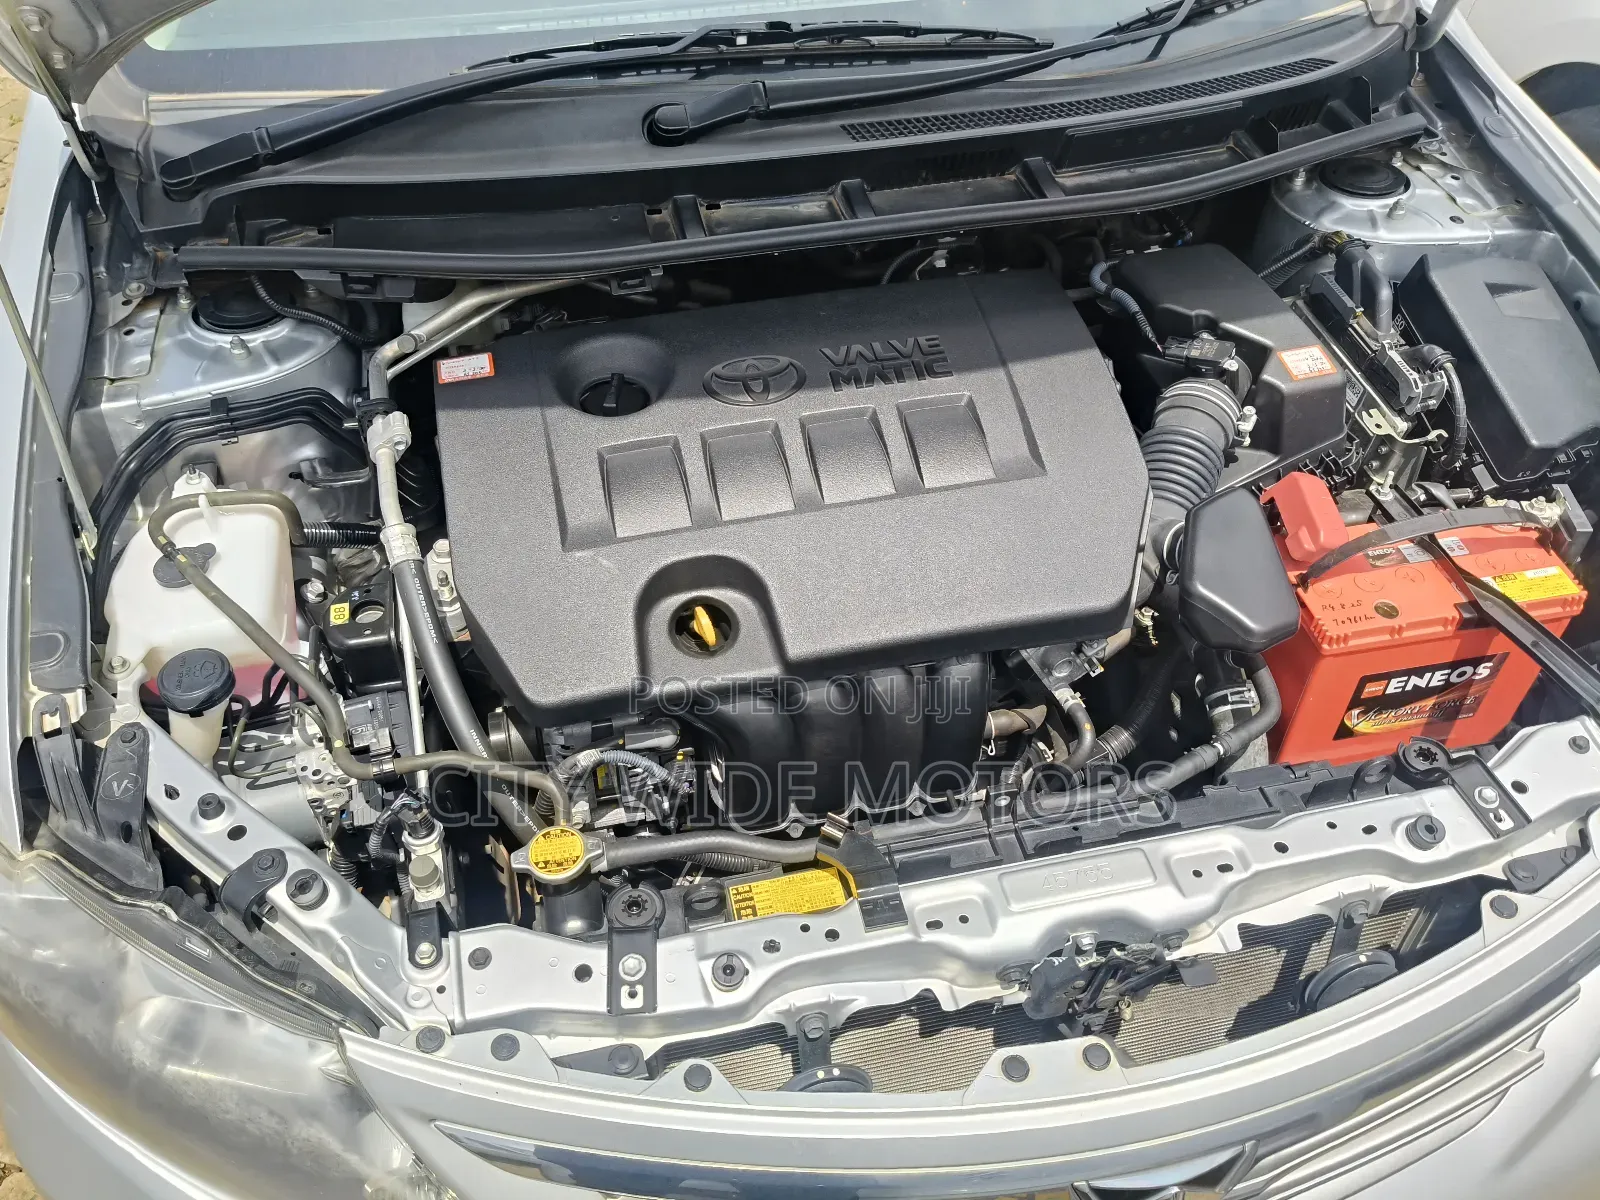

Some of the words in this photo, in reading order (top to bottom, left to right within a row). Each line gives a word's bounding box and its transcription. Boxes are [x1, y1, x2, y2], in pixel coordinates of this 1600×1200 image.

[819, 335, 945, 367] VALVE
[829, 356, 954, 392] MATIC
[1385, 662, 1493, 694] ENEOS
